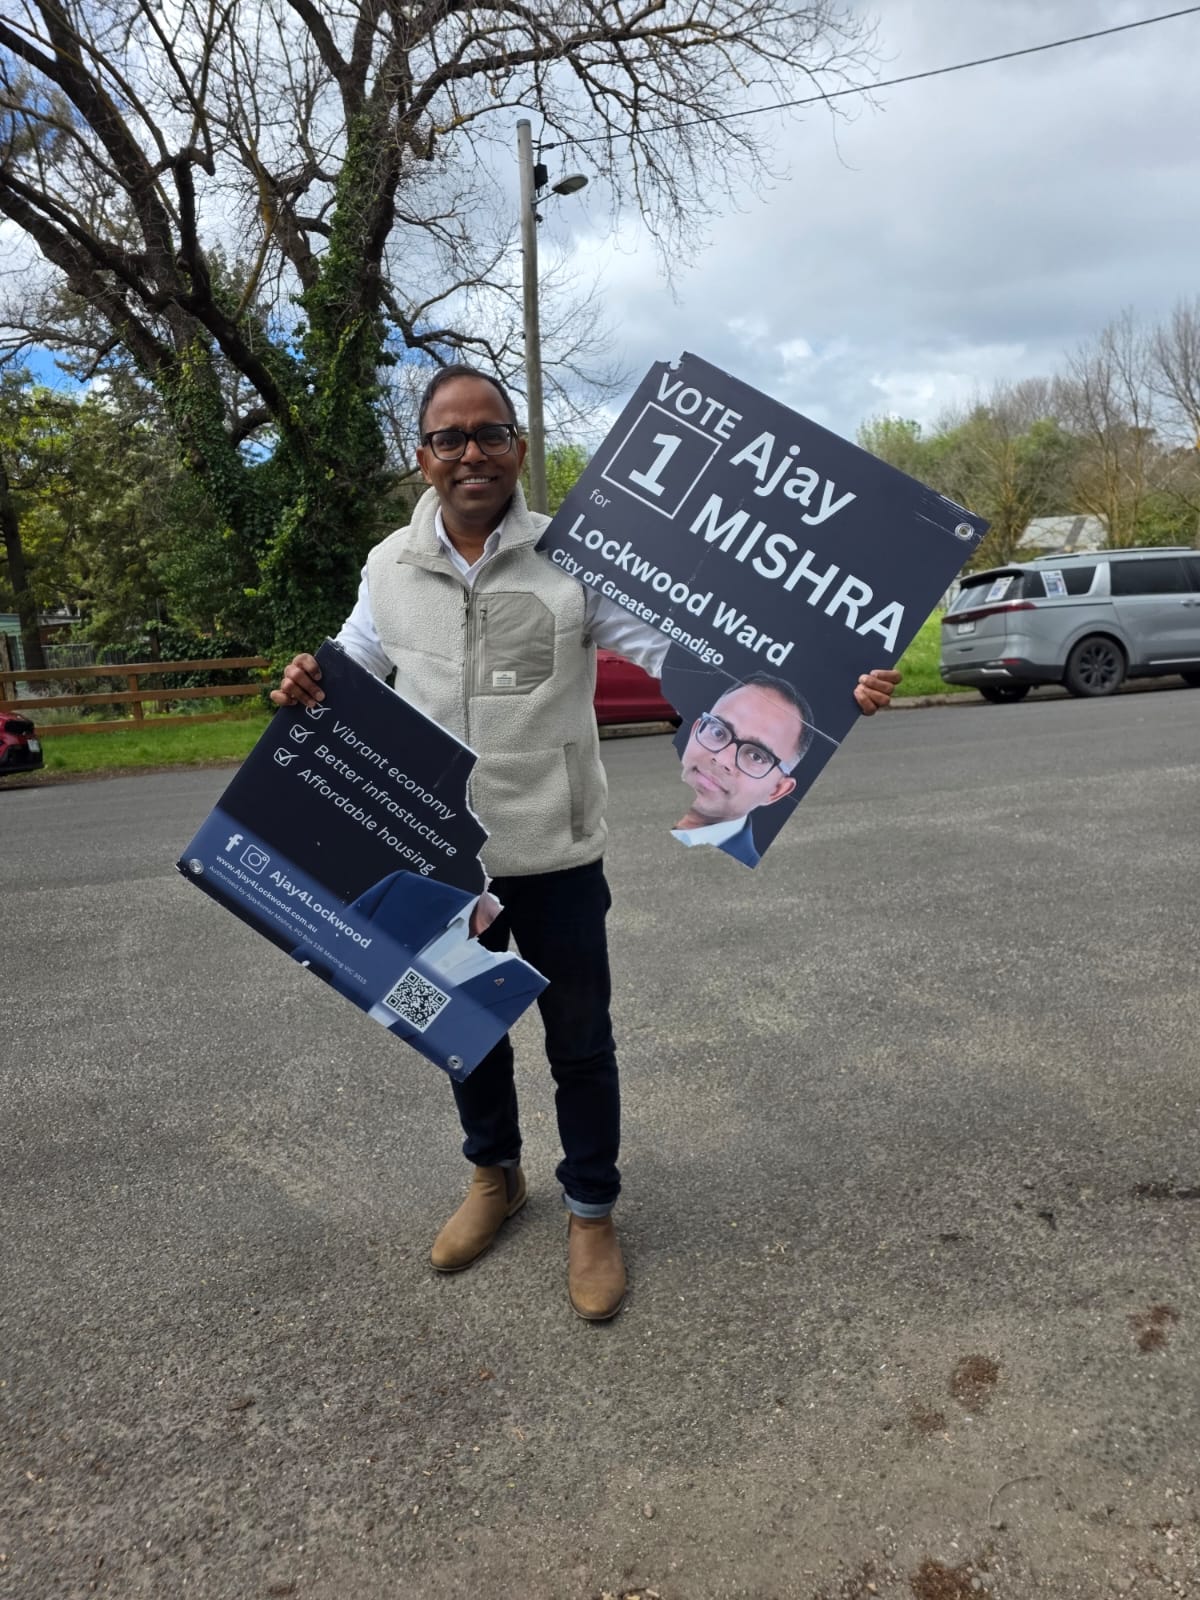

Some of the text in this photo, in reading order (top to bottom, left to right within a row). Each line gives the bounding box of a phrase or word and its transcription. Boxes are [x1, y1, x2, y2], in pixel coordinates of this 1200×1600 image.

[657, 372, 743, 440] VOTE
[589, 488, 612, 508] for
[628, 433, 683, 497] 1
[729, 431, 857, 526] Ajay
[551, 548, 725, 665] City of Greater Bendigo
[568, 513, 795, 667] Lockwood Ward
[689, 493, 906, 654] MISHRA
[314, 744, 457, 857] Better infrastucture
[332, 720, 457, 820] Vibrant economy
[297, 767, 436, 876] Affordable housing
[216, 855, 318, 934] www.Ajay4Lockwood.com.au
[269, 870, 373, 949] Ajay4Lockwood
